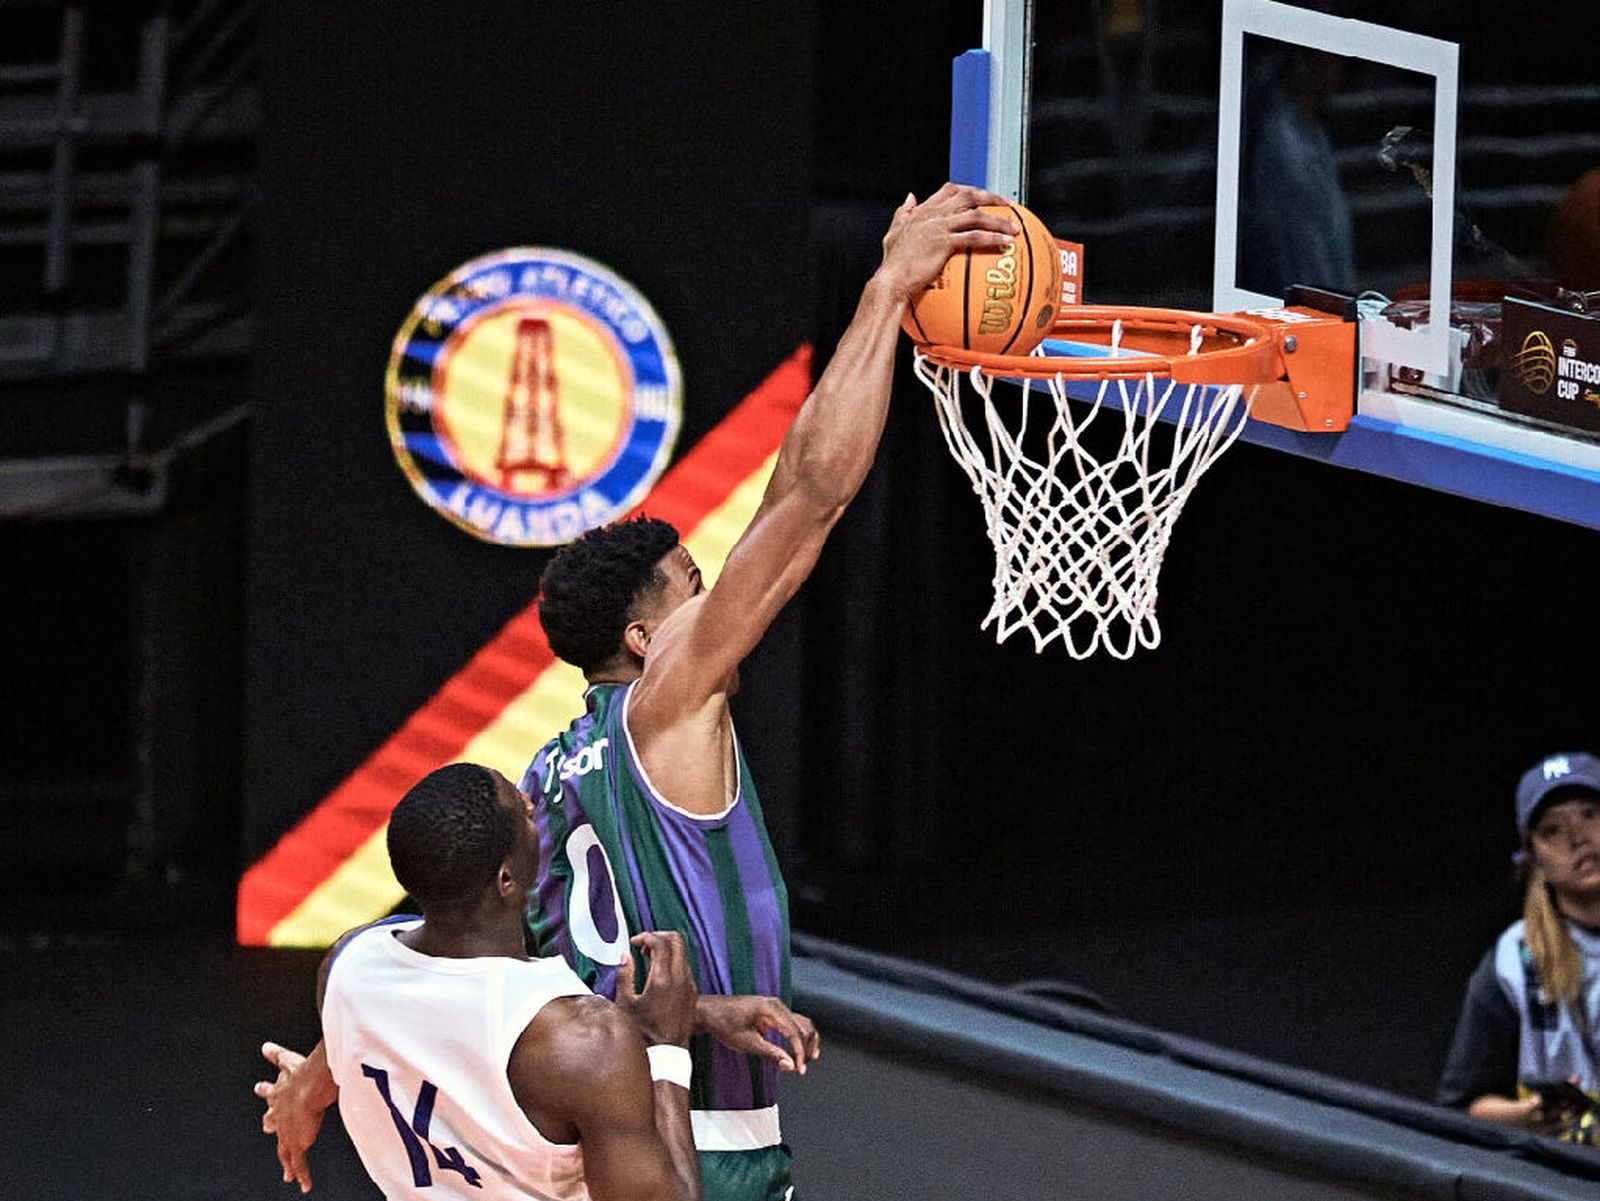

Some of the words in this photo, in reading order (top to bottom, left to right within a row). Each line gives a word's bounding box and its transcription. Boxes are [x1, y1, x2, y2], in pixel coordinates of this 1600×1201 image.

[979, 243, 1016, 335] Wilso
[1060, 250, 1077, 277] BA
[1557, 379, 1579, 400] CUP
[566, 823, 631, 965] 0
[361, 1063, 483, 1188] 14
